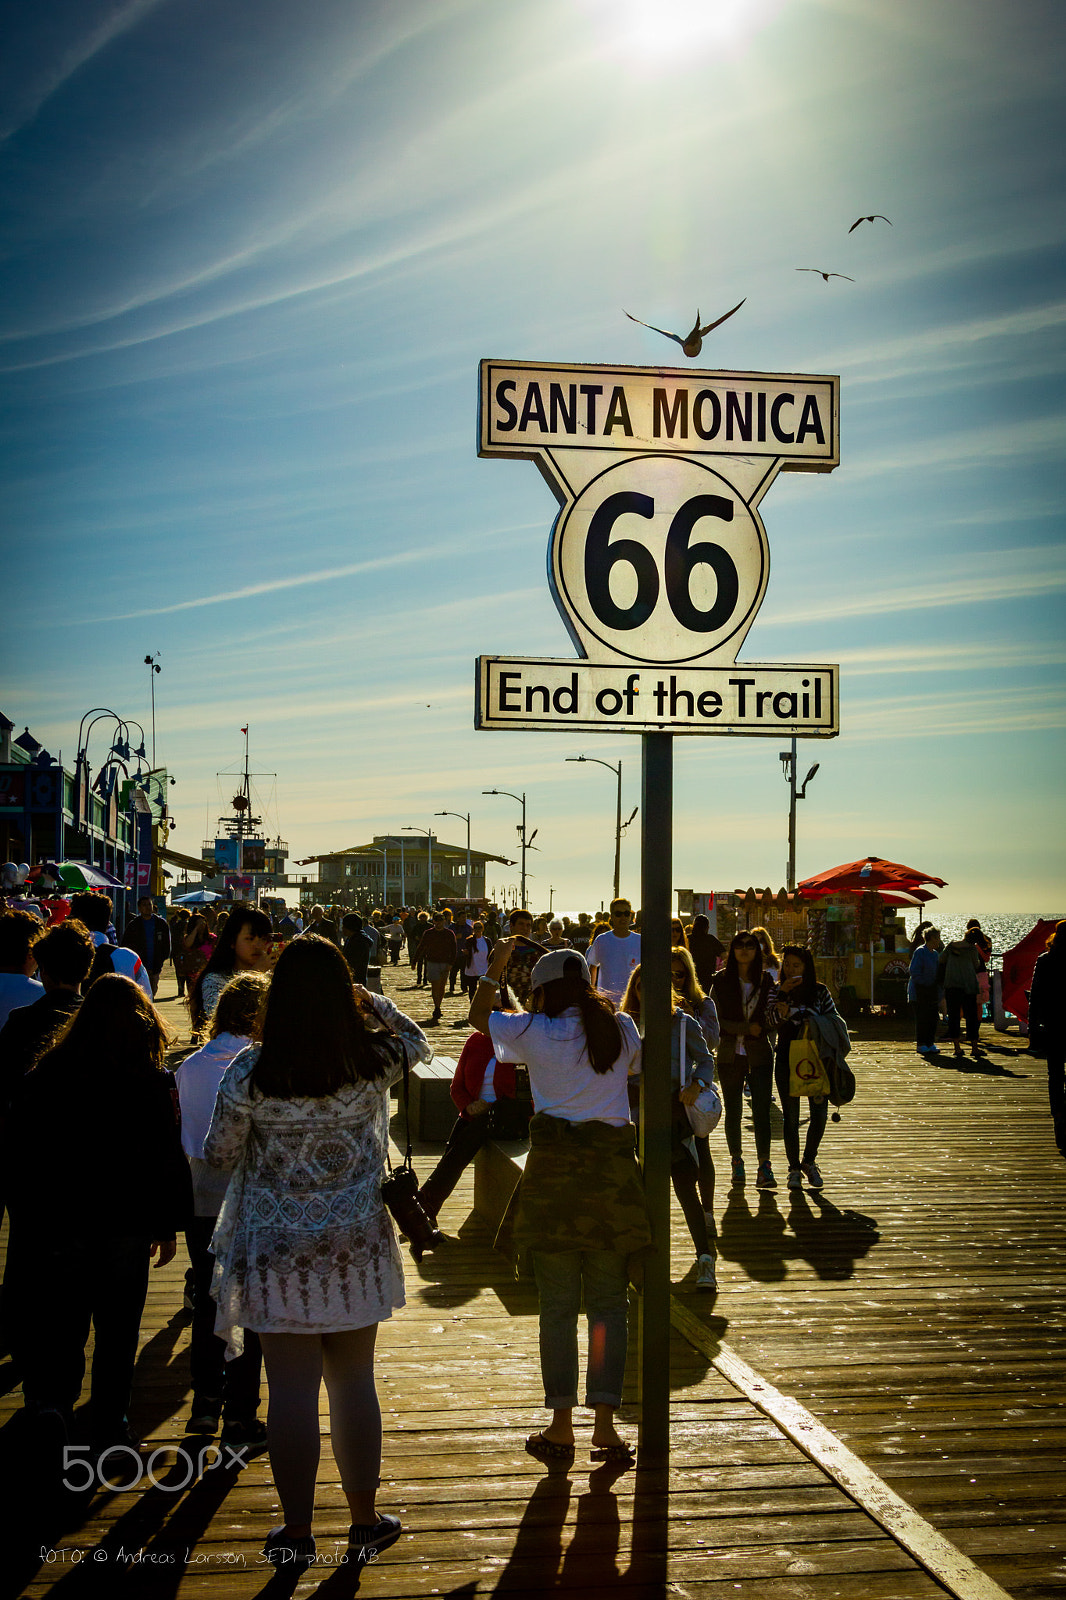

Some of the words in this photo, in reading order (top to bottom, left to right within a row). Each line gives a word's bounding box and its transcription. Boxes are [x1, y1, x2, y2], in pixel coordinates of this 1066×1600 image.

[495, 379, 634, 437] SANTA
[652, 387, 826, 445] MONICA
[584, 491, 739, 633] 66
[498, 671, 579, 714] End
[595, 673, 640, 716] of
[653, 675, 723, 718] the
[728, 677, 822, 719] Trail
[796, 1058, 821, 1080] Q
